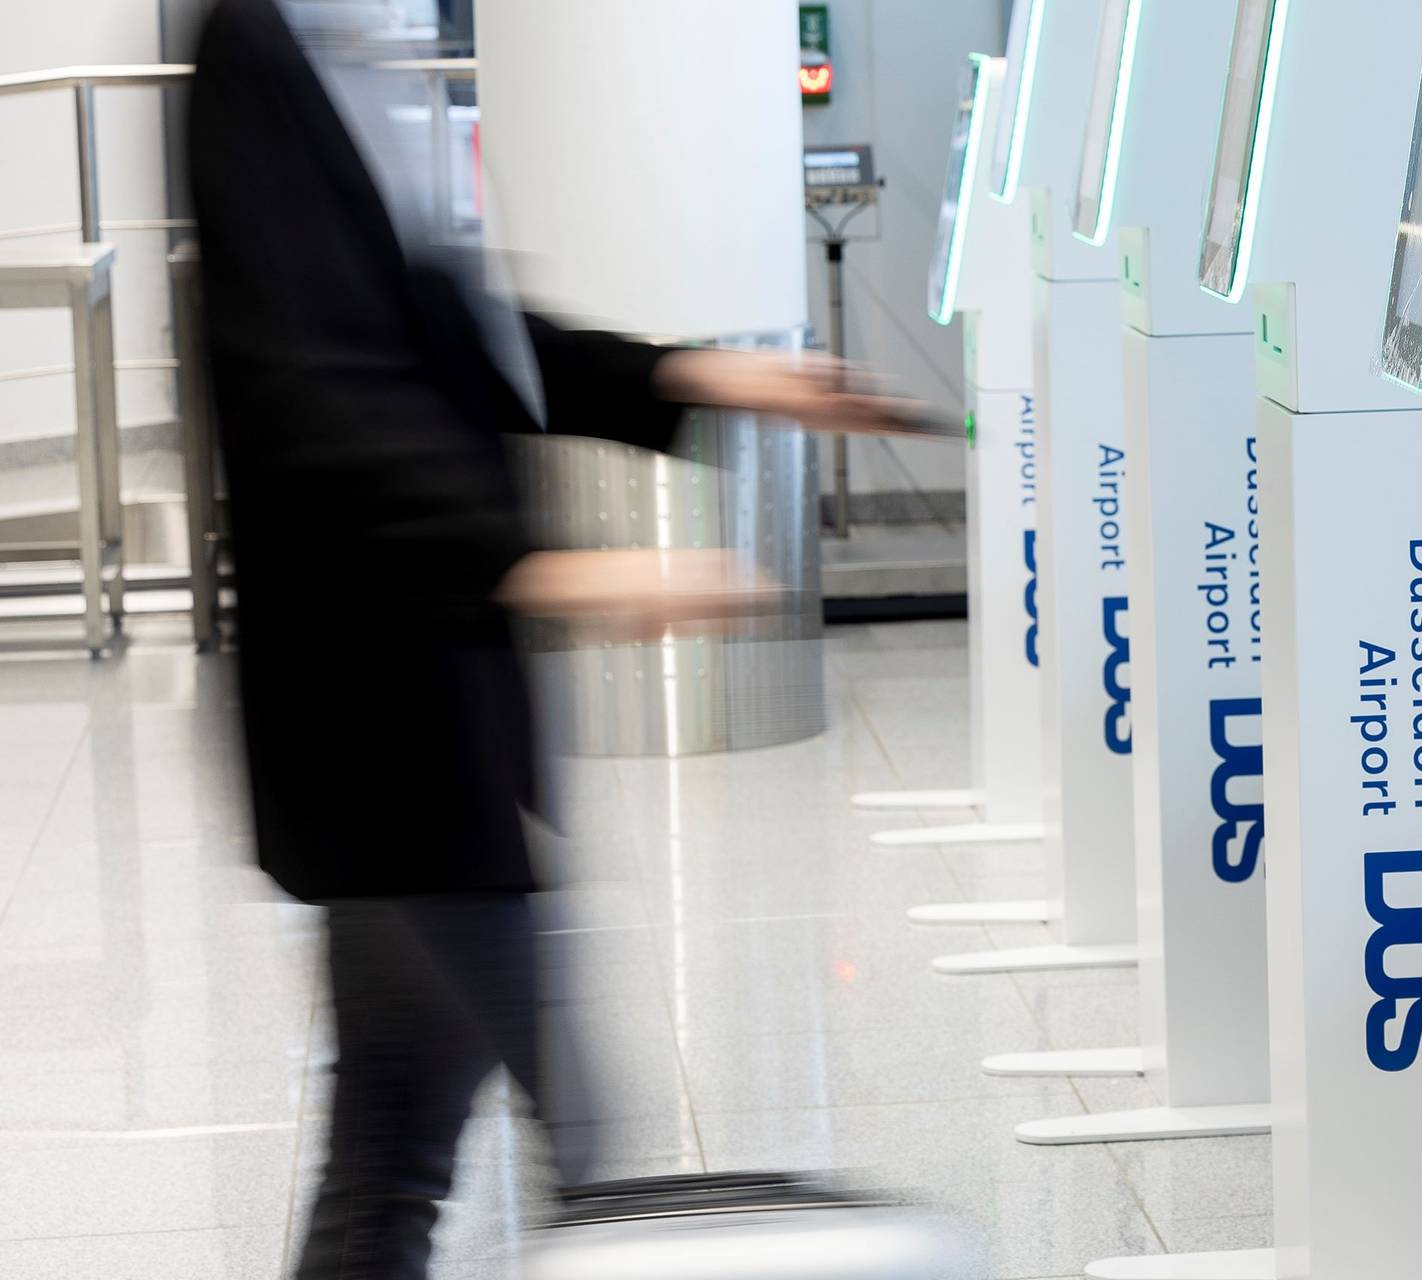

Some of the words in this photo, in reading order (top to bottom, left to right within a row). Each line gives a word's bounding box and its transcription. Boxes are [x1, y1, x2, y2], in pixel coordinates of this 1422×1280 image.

[1092, 444, 1126, 569] Airport
[1198, 521, 1237, 670] Airport
[1208, 696, 1264, 884] DUS
[1350, 639, 1398, 817] Airport
